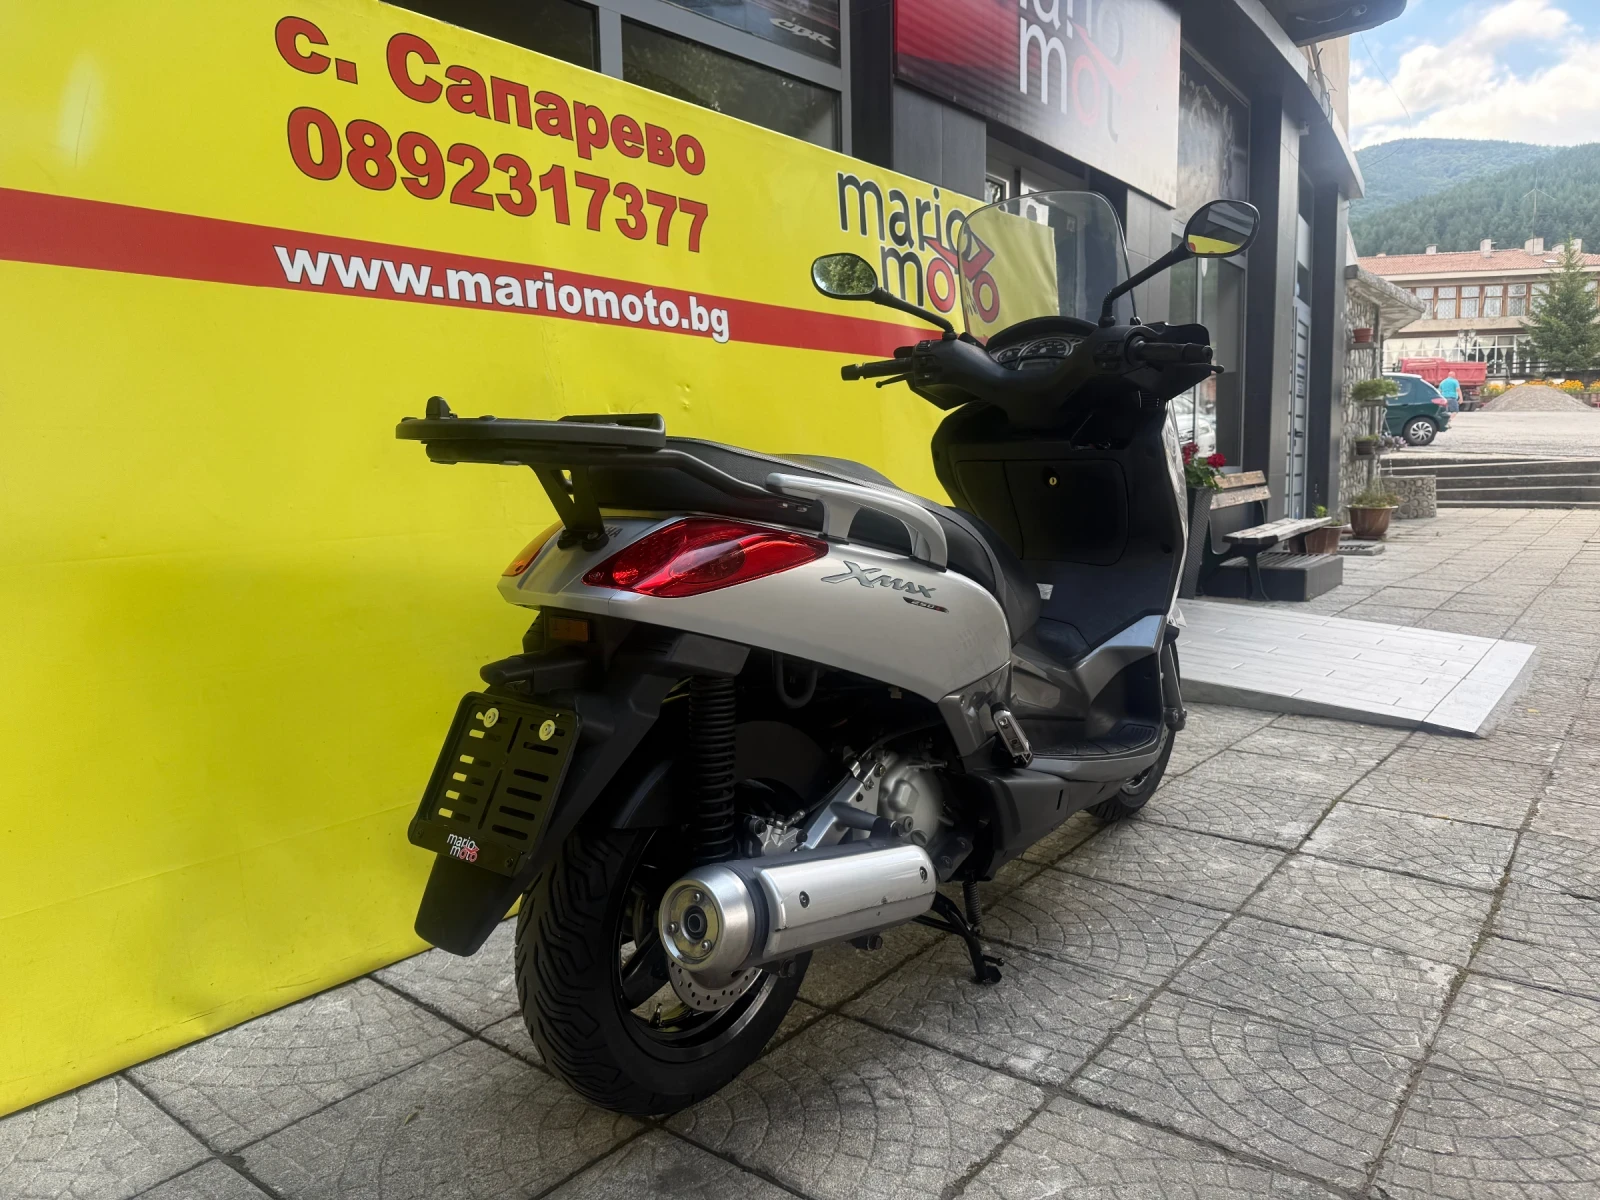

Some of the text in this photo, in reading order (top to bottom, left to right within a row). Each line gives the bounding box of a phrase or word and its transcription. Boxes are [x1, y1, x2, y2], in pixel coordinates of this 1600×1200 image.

[386, 32, 706, 176] Сапарево
[287, 106, 709, 253] 0892317377
[837, 172, 971, 259] mario
[273, 244, 730, 344] www.mariomoto.bg
[446, 833, 476, 850] mario
[450, 845, 478, 862] moto
